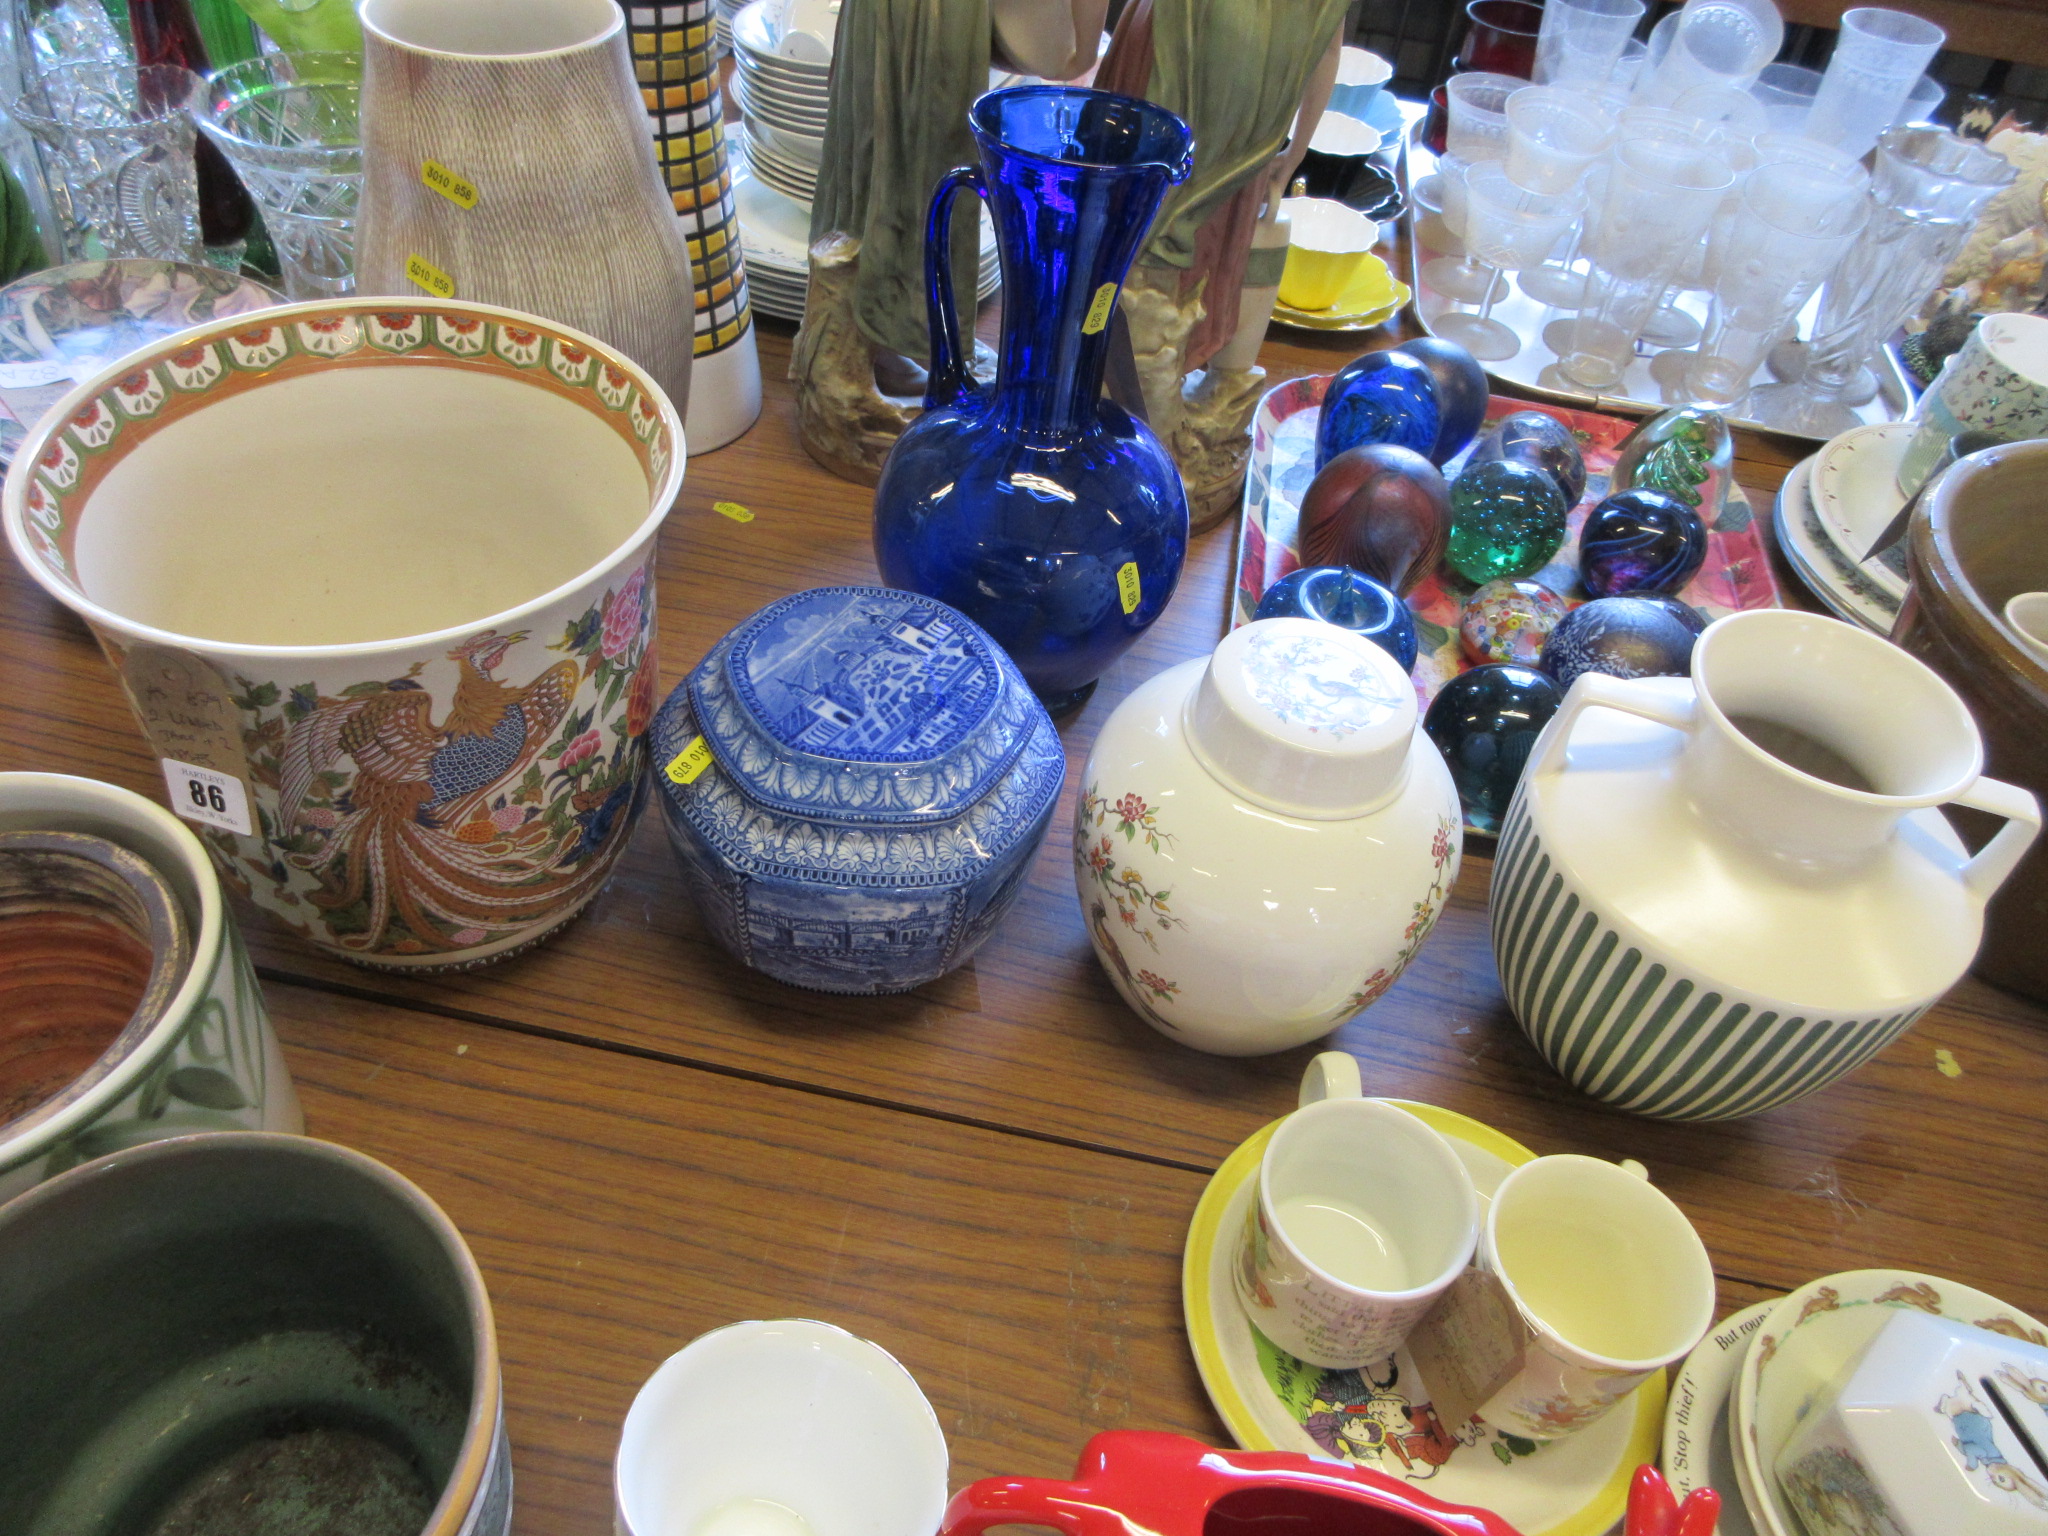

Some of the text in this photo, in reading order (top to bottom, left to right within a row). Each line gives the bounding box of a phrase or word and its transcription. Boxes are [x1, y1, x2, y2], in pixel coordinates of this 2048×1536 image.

[427, 165, 472, 201] 3010 858
[411, 261, 449, 294] 3010 858
[1123, 566, 1135, 589] 3010
[181, 767, 226, 786] HARTLEYS
[672, 741, 709, 779] 010 879
[188, 779, 227, 813] 86
[1714, 1306, 1774, 1351] But roun
